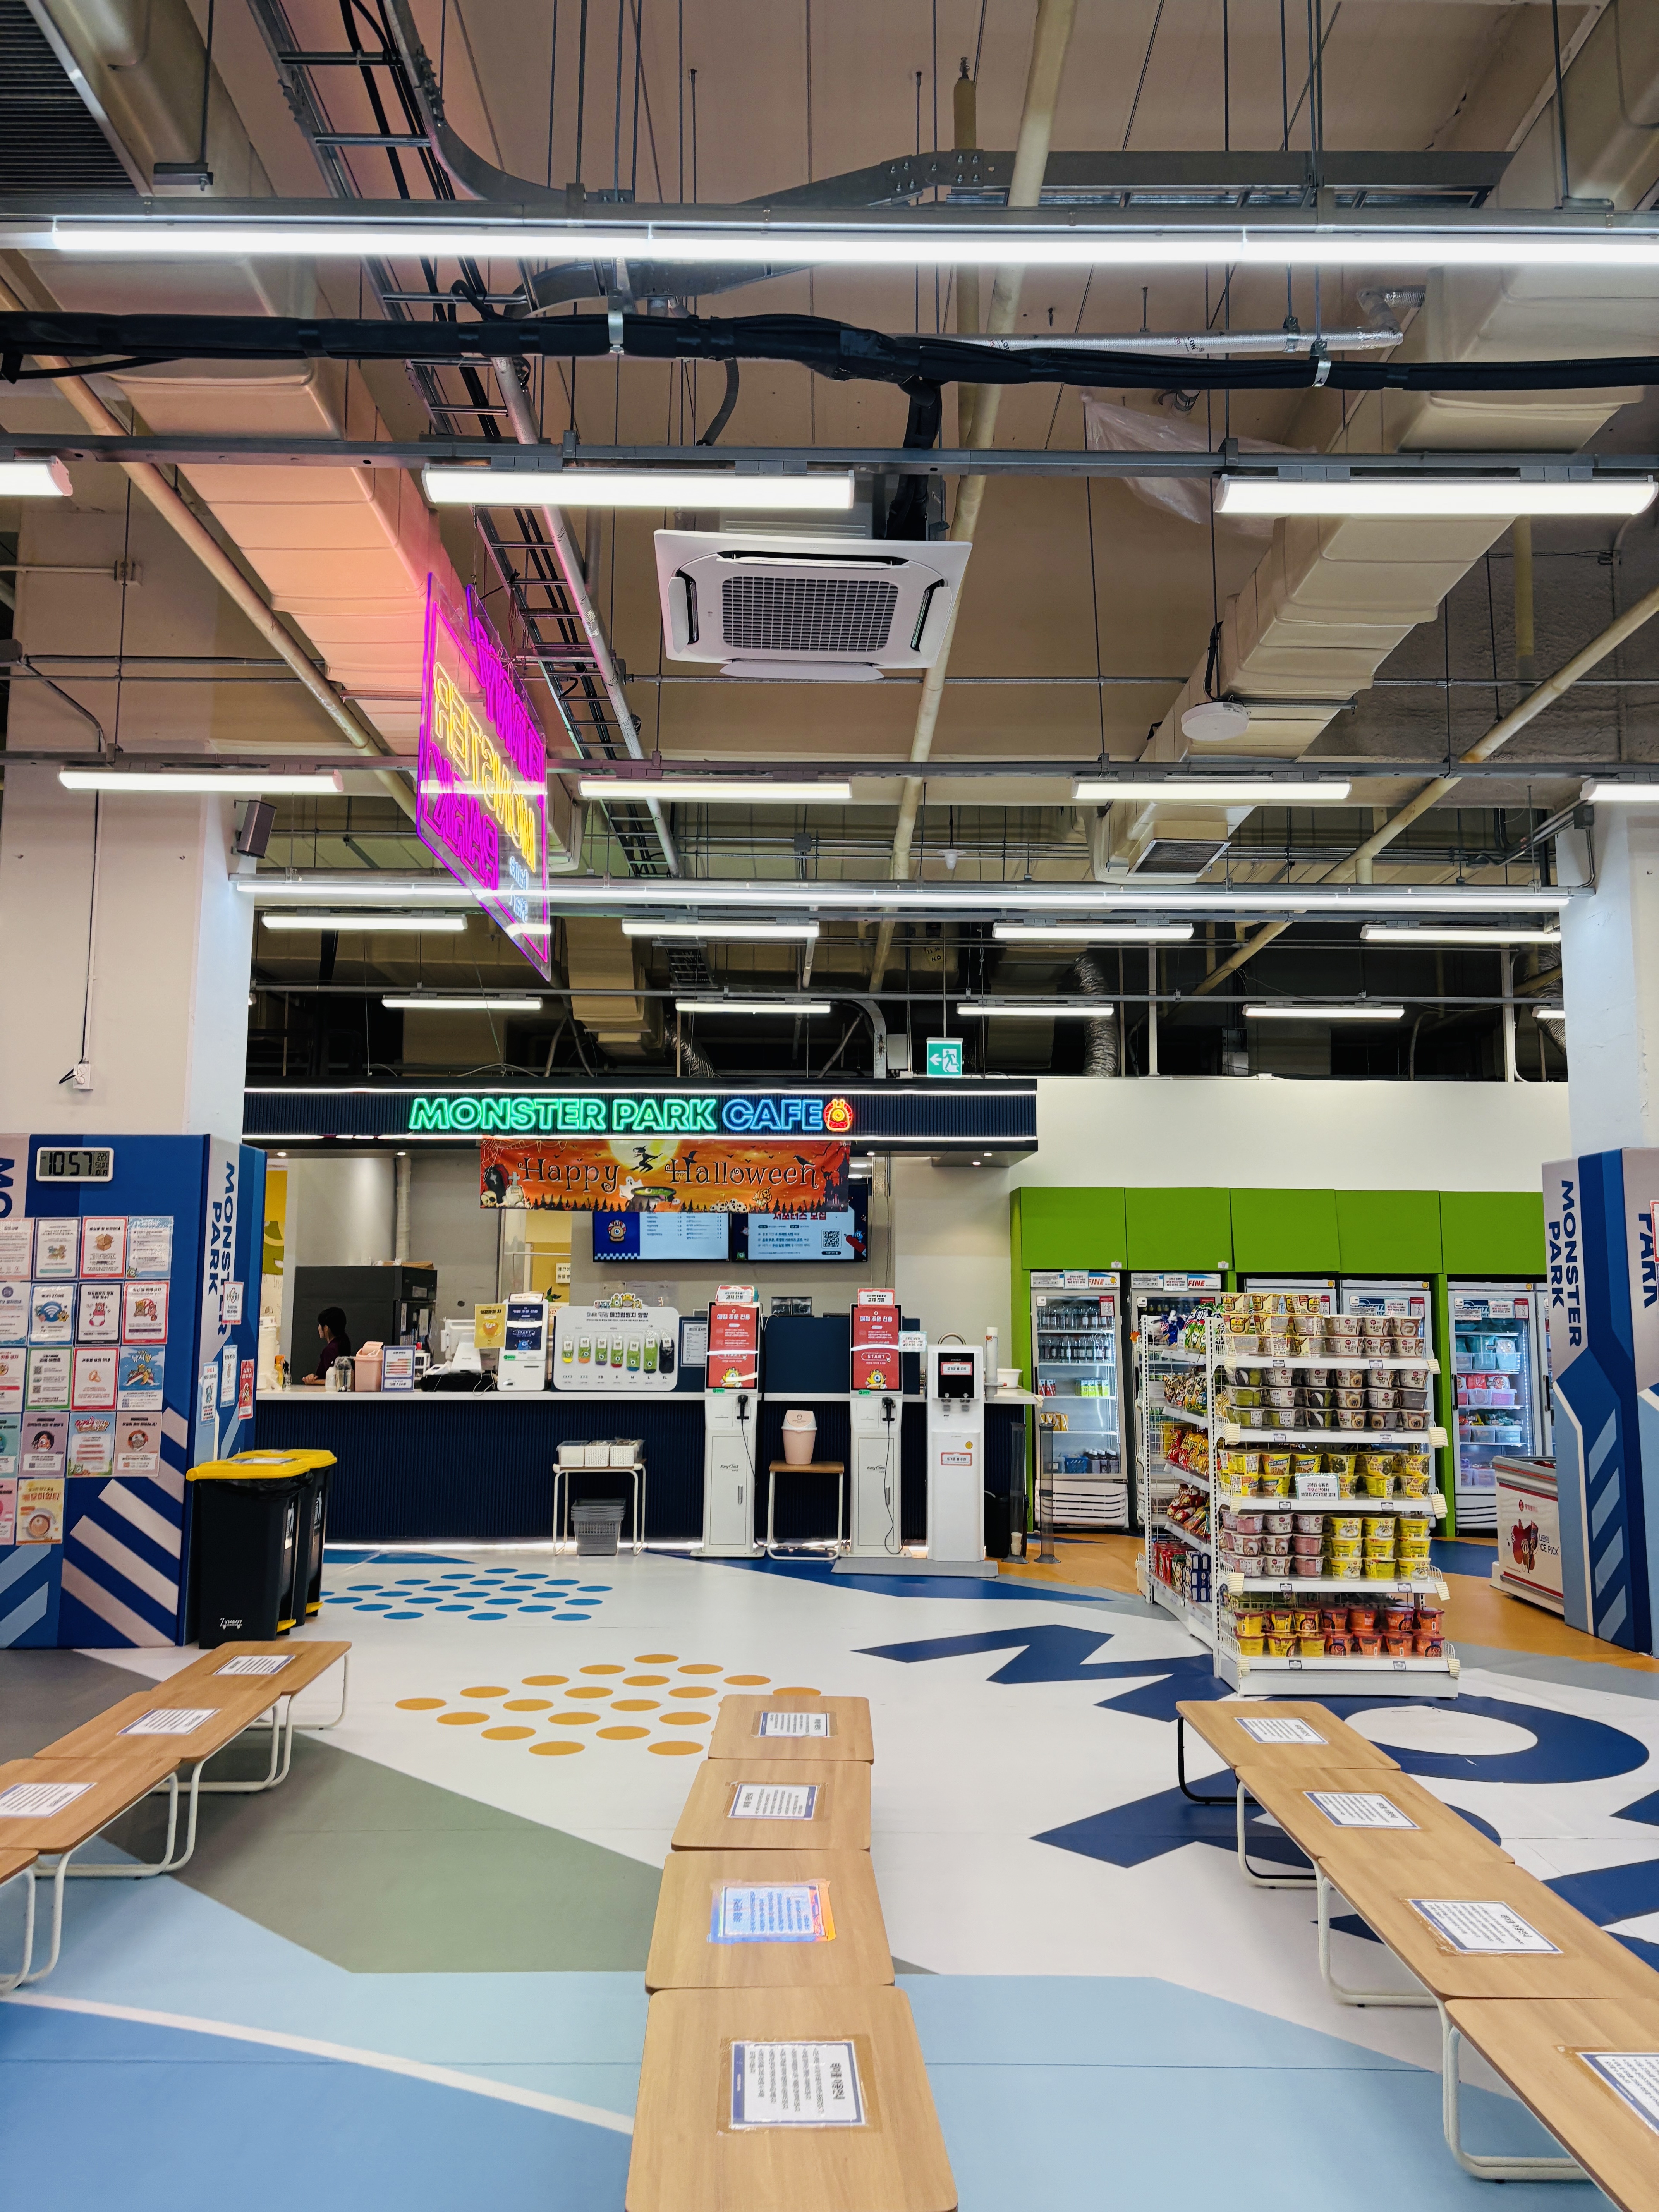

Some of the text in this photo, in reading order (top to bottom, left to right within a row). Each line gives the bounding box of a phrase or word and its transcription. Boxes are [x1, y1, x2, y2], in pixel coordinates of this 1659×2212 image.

[409, 1097, 824, 1132] MONSTER PARK CAFE
[517, 1156, 820, 1193] Happy Halloween
[208, 1201, 222, 1295] PARK
[218, 1161, 235, 1336] MONSTR
[1548, 1221, 1565, 1309] PARK
[1561, 1180, 1582, 1347] MONSTER
